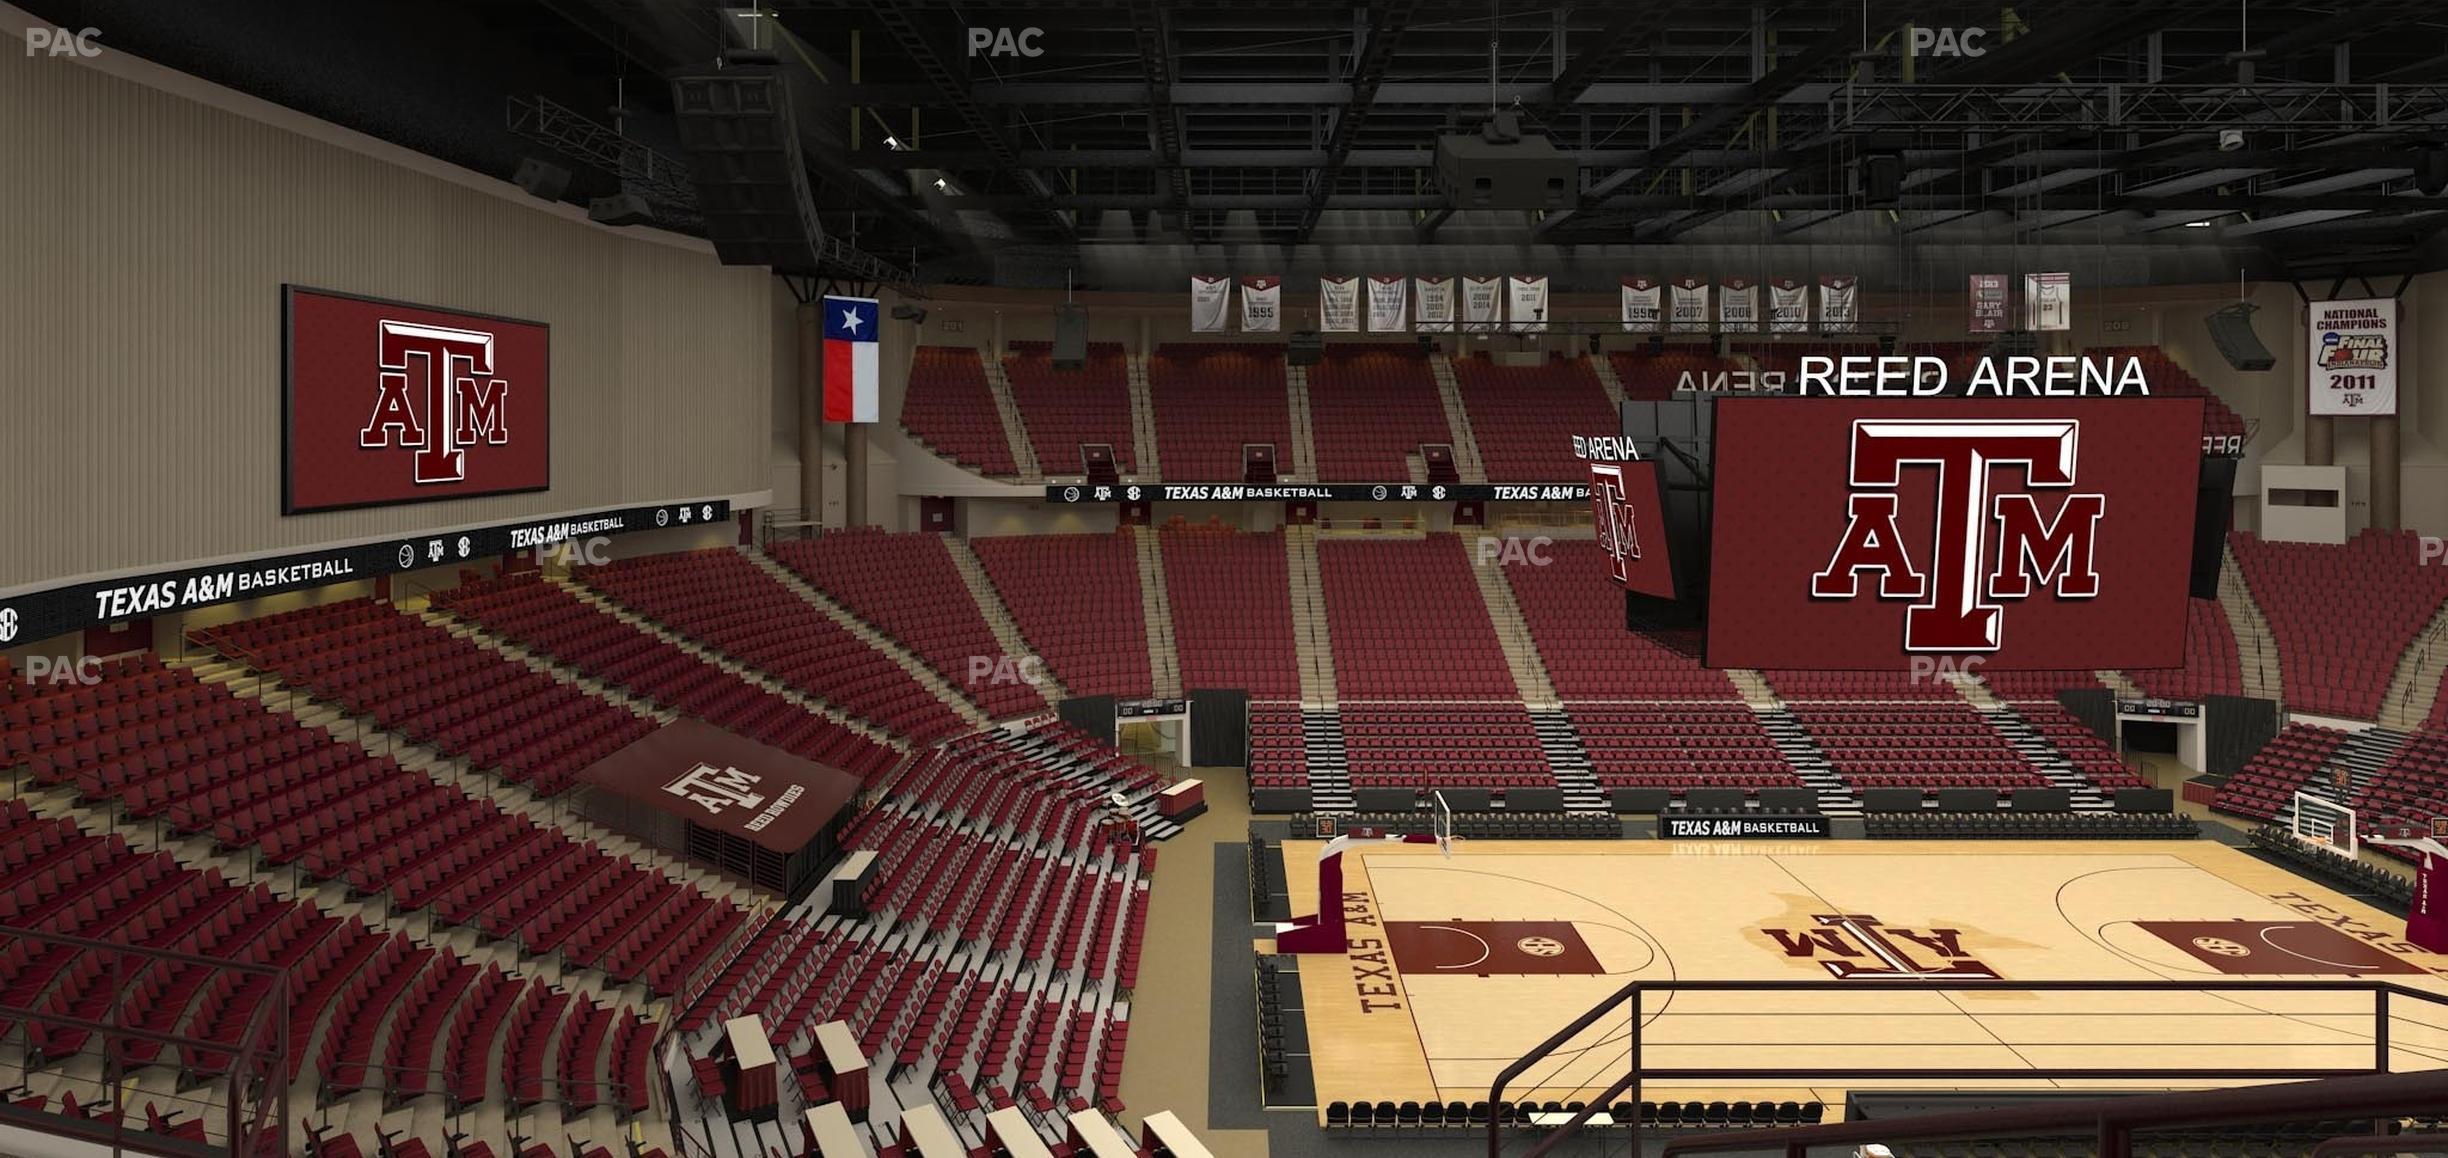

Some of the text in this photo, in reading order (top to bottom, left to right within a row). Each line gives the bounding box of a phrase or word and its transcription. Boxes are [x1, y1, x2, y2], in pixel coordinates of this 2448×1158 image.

[1248, 306, 1274, 318] 1995
[1676, 307, 1703, 318] 2007
[2324, 308, 2379, 319] NATIONAL
[2317, 319, 2387, 330] CHAMPIONS
[2338, 336, 2384, 348] FINAL
[1800, 356, 2150, 396] REED ARENA
[2330, 375, 2376, 389] 2011
[1589, 436, 1640, 460] ARENA
[1164, 487, 1332, 499] TEXAS A&M BASKETBALL
[1494, 486, 1538, 499] TEXAS
[1541, 486, 1573, 499] A&M
[511, 517, 624, 548] TEXAS A&M BASKETBALL
[96, 558, 354, 619] TEXAS A&M BASKETBALL
[744, 784, 805, 832] REED ROWDIES
[1671, 820, 1820, 836] TEXAS A&M BASKETBALL
[2271, 892, 2429, 955] TEXAS
[1343, 891, 1402, 1014] TEXAS A&M
